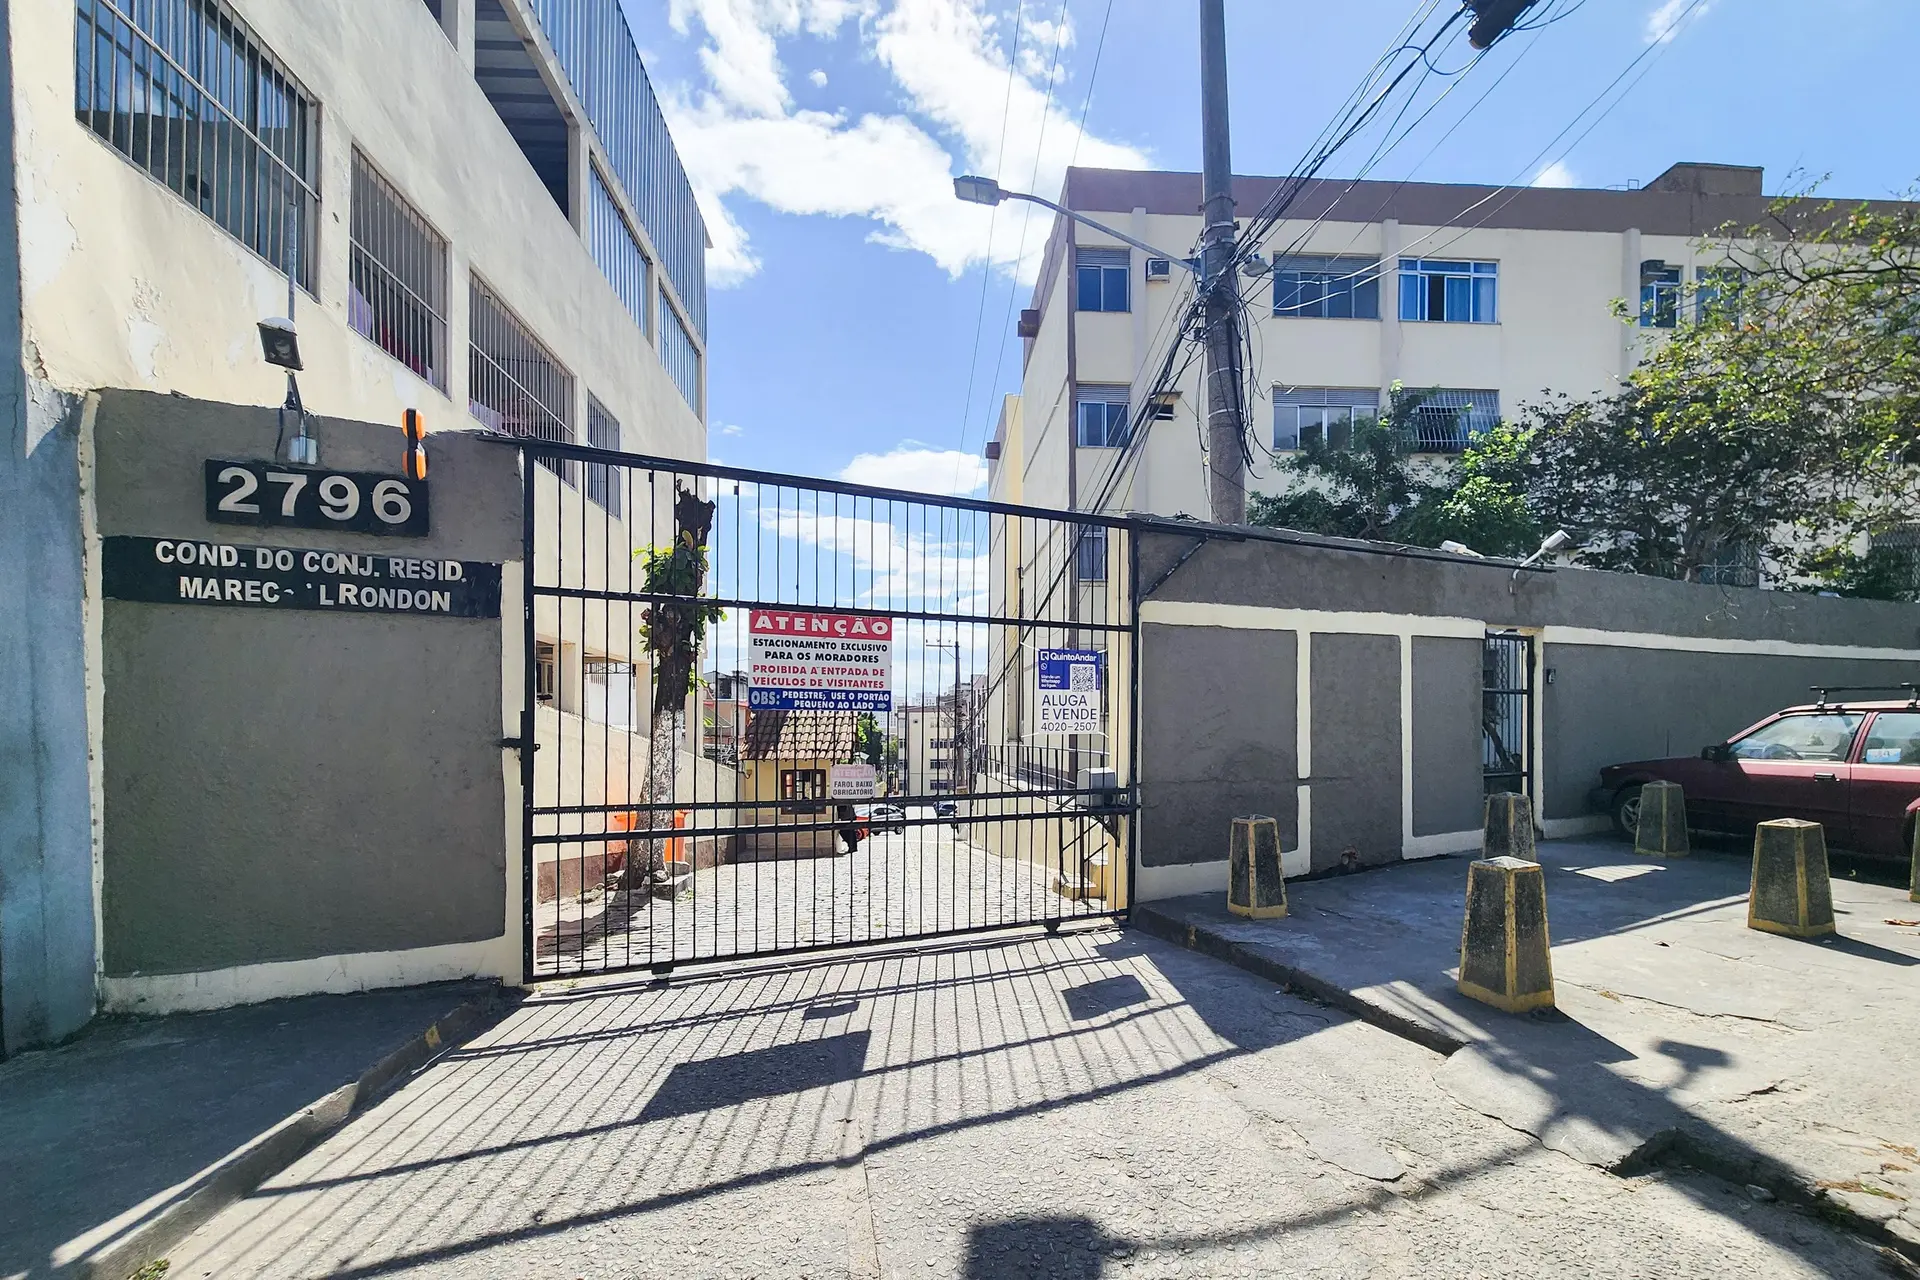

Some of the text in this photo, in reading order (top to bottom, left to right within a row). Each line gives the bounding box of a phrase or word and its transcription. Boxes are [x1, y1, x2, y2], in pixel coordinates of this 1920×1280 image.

[217, 466, 412, 524] 2796
[155, 540, 467, 583] COND. DO CONJ. RESID.
[180, 576, 450, 612] MARECL RONDON
[754, 615, 888, 636] ATENÇÃO
[753, 638, 888, 653] ESTACIONAMENTO EXCLUSIVO
[764, 651, 879, 664] PARA OS MORADORES
[1050, 652, 1097, 661] QuintoAndar
[752, 664, 807, 675] PROIBIDA
[810, 666, 818, 675] A
[872, 668, 885, 677] DE
[809, 678, 823, 687] DE
[826, 678, 884, 689] VISITANTES
[750, 690, 781, 706] OBS:
[831, 692, 846, 700] USE
[794, 700, 874, 709] PEQUENO AO LADO
[1041, 694, 1087, 706] ALUGA
[1042, 708, 1097, 720] E VENDE
[1041, 721, 1097, 732] 4020-2507
[834, 780, 873, 788] FAROL BAIXO
